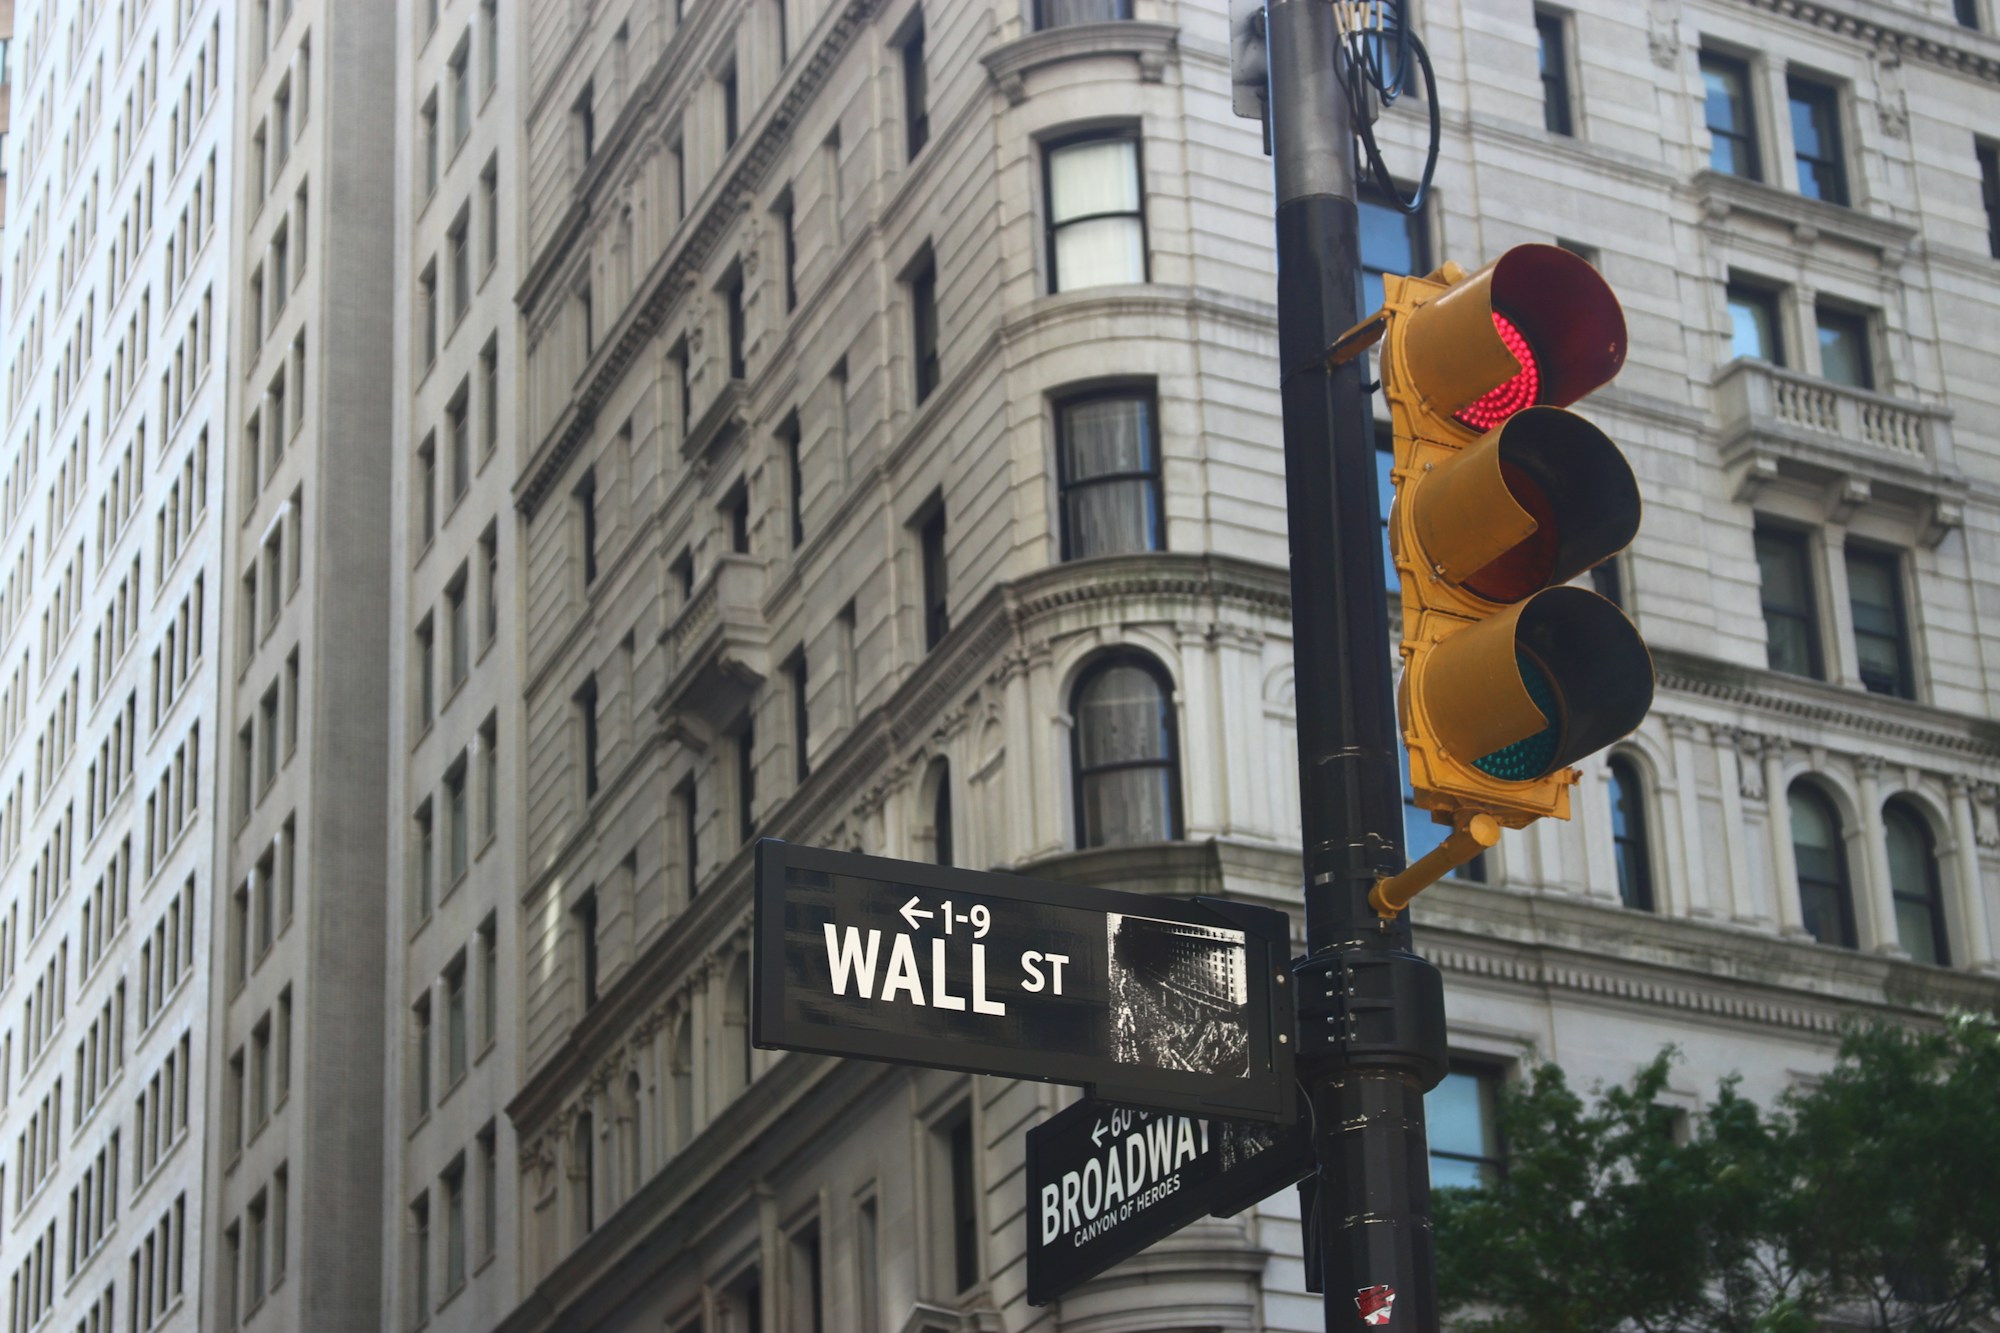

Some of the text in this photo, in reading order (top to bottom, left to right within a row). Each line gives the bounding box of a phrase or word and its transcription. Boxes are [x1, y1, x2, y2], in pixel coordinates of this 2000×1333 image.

[940, 900, 991, 939] 1-9
[823, 922, 1070, 1017] WALL ST
[1041, 1115, 1209, 1246] BROADWAY
[1074, 1173, 1181, 1248] CANYON OF HEROES
